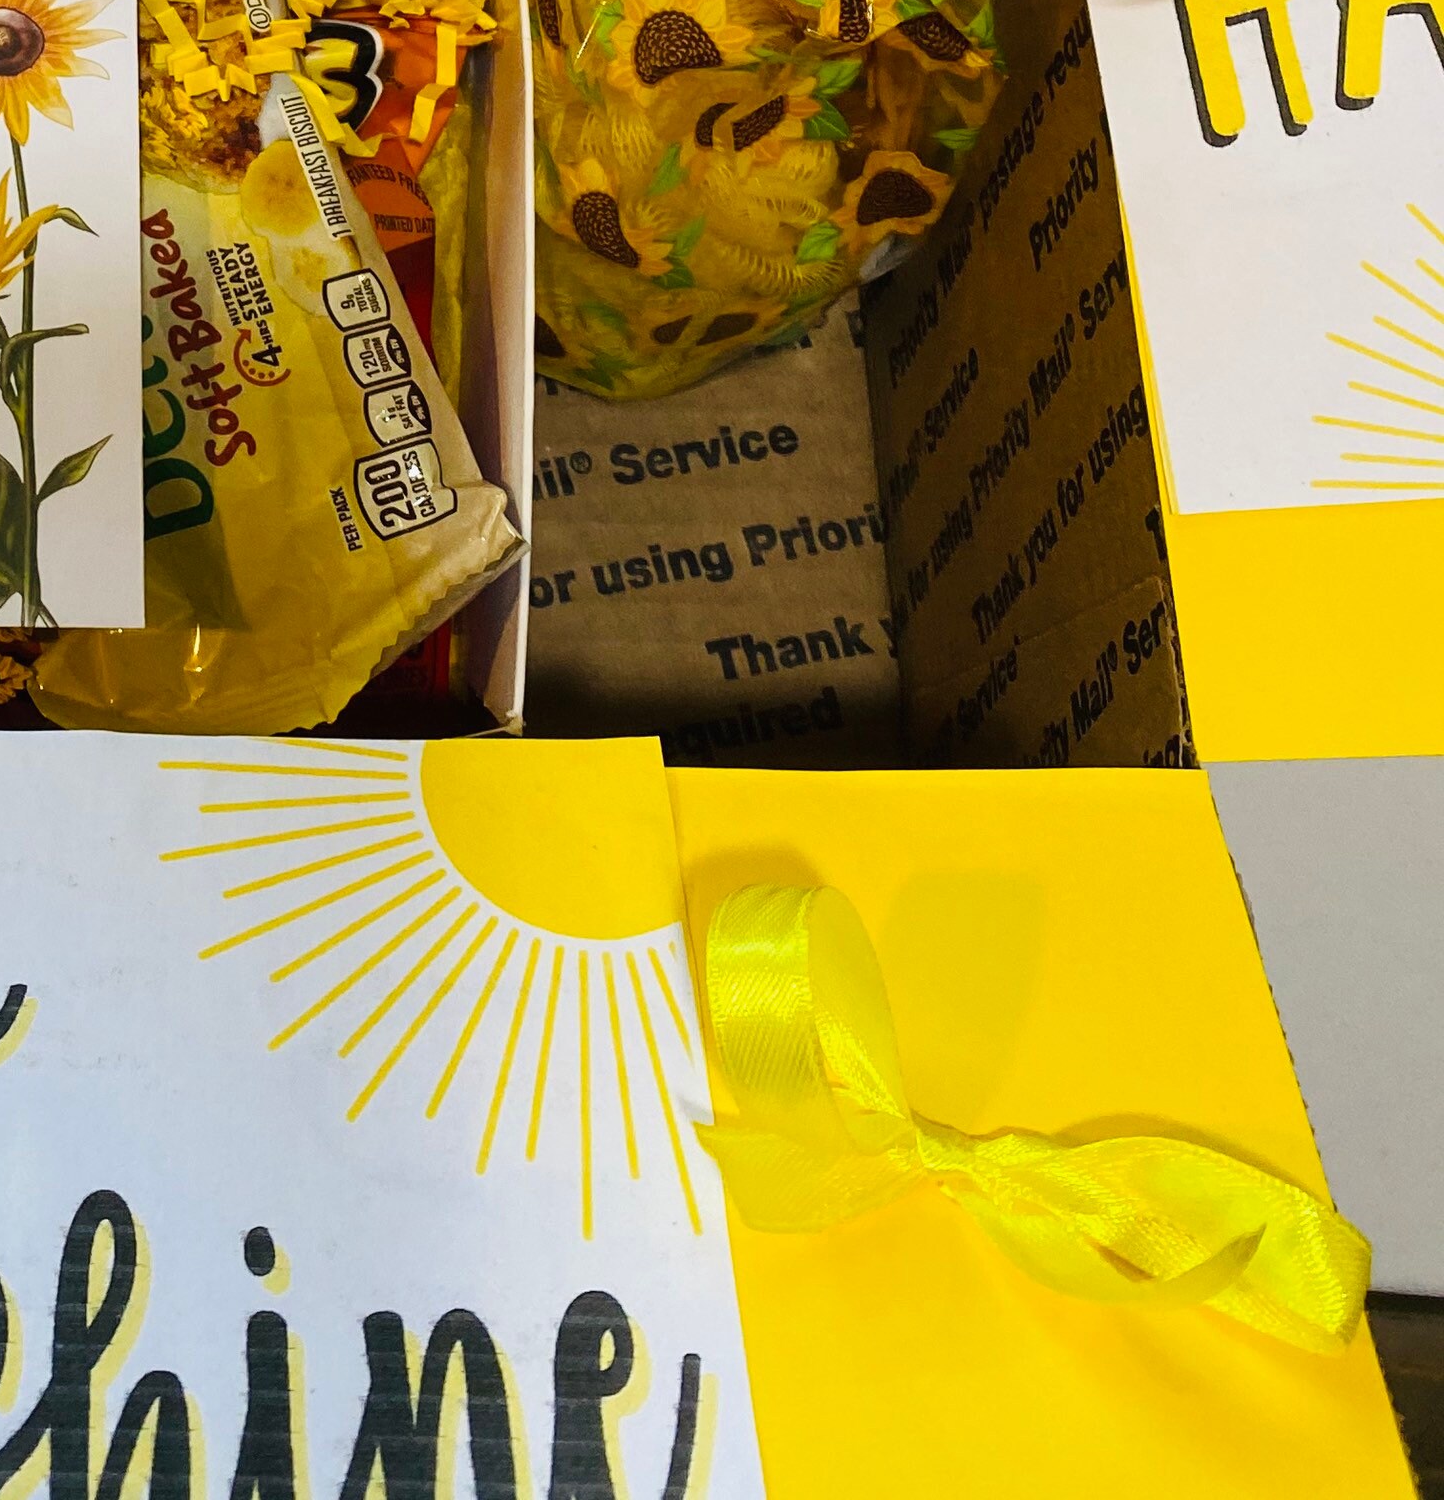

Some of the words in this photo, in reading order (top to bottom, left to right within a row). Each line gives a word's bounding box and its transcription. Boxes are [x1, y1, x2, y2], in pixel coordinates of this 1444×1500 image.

[281, 94, 321, 153] BISCUIT
[305, 153, 347, 228] BREAKFAST
[1028, 137, 1101, 273] Priority
[206, 249, 242, 326] NUTRITIOUS
[218, 246, 258, 322] STEADY
[233, 242, 275, 315] ENERGY
[182, 362, 257, 467] Soft
[609, 423, 799, 486] Service
[328, 485, 354, 522] PACK
[364, 459, 417, 529] 200
[971, 553, 1027, 645] Thank
[1023, 507, 1060, 586] you
[1056, 462, 1086, 529] for
[1090, 383, 1149, 484] using
[341, 520, 364, 553] PER
[591, 541, 735, 598] using
[705, 615, 875, 681] Thank
[968, 399, 1031, 511] Priority
